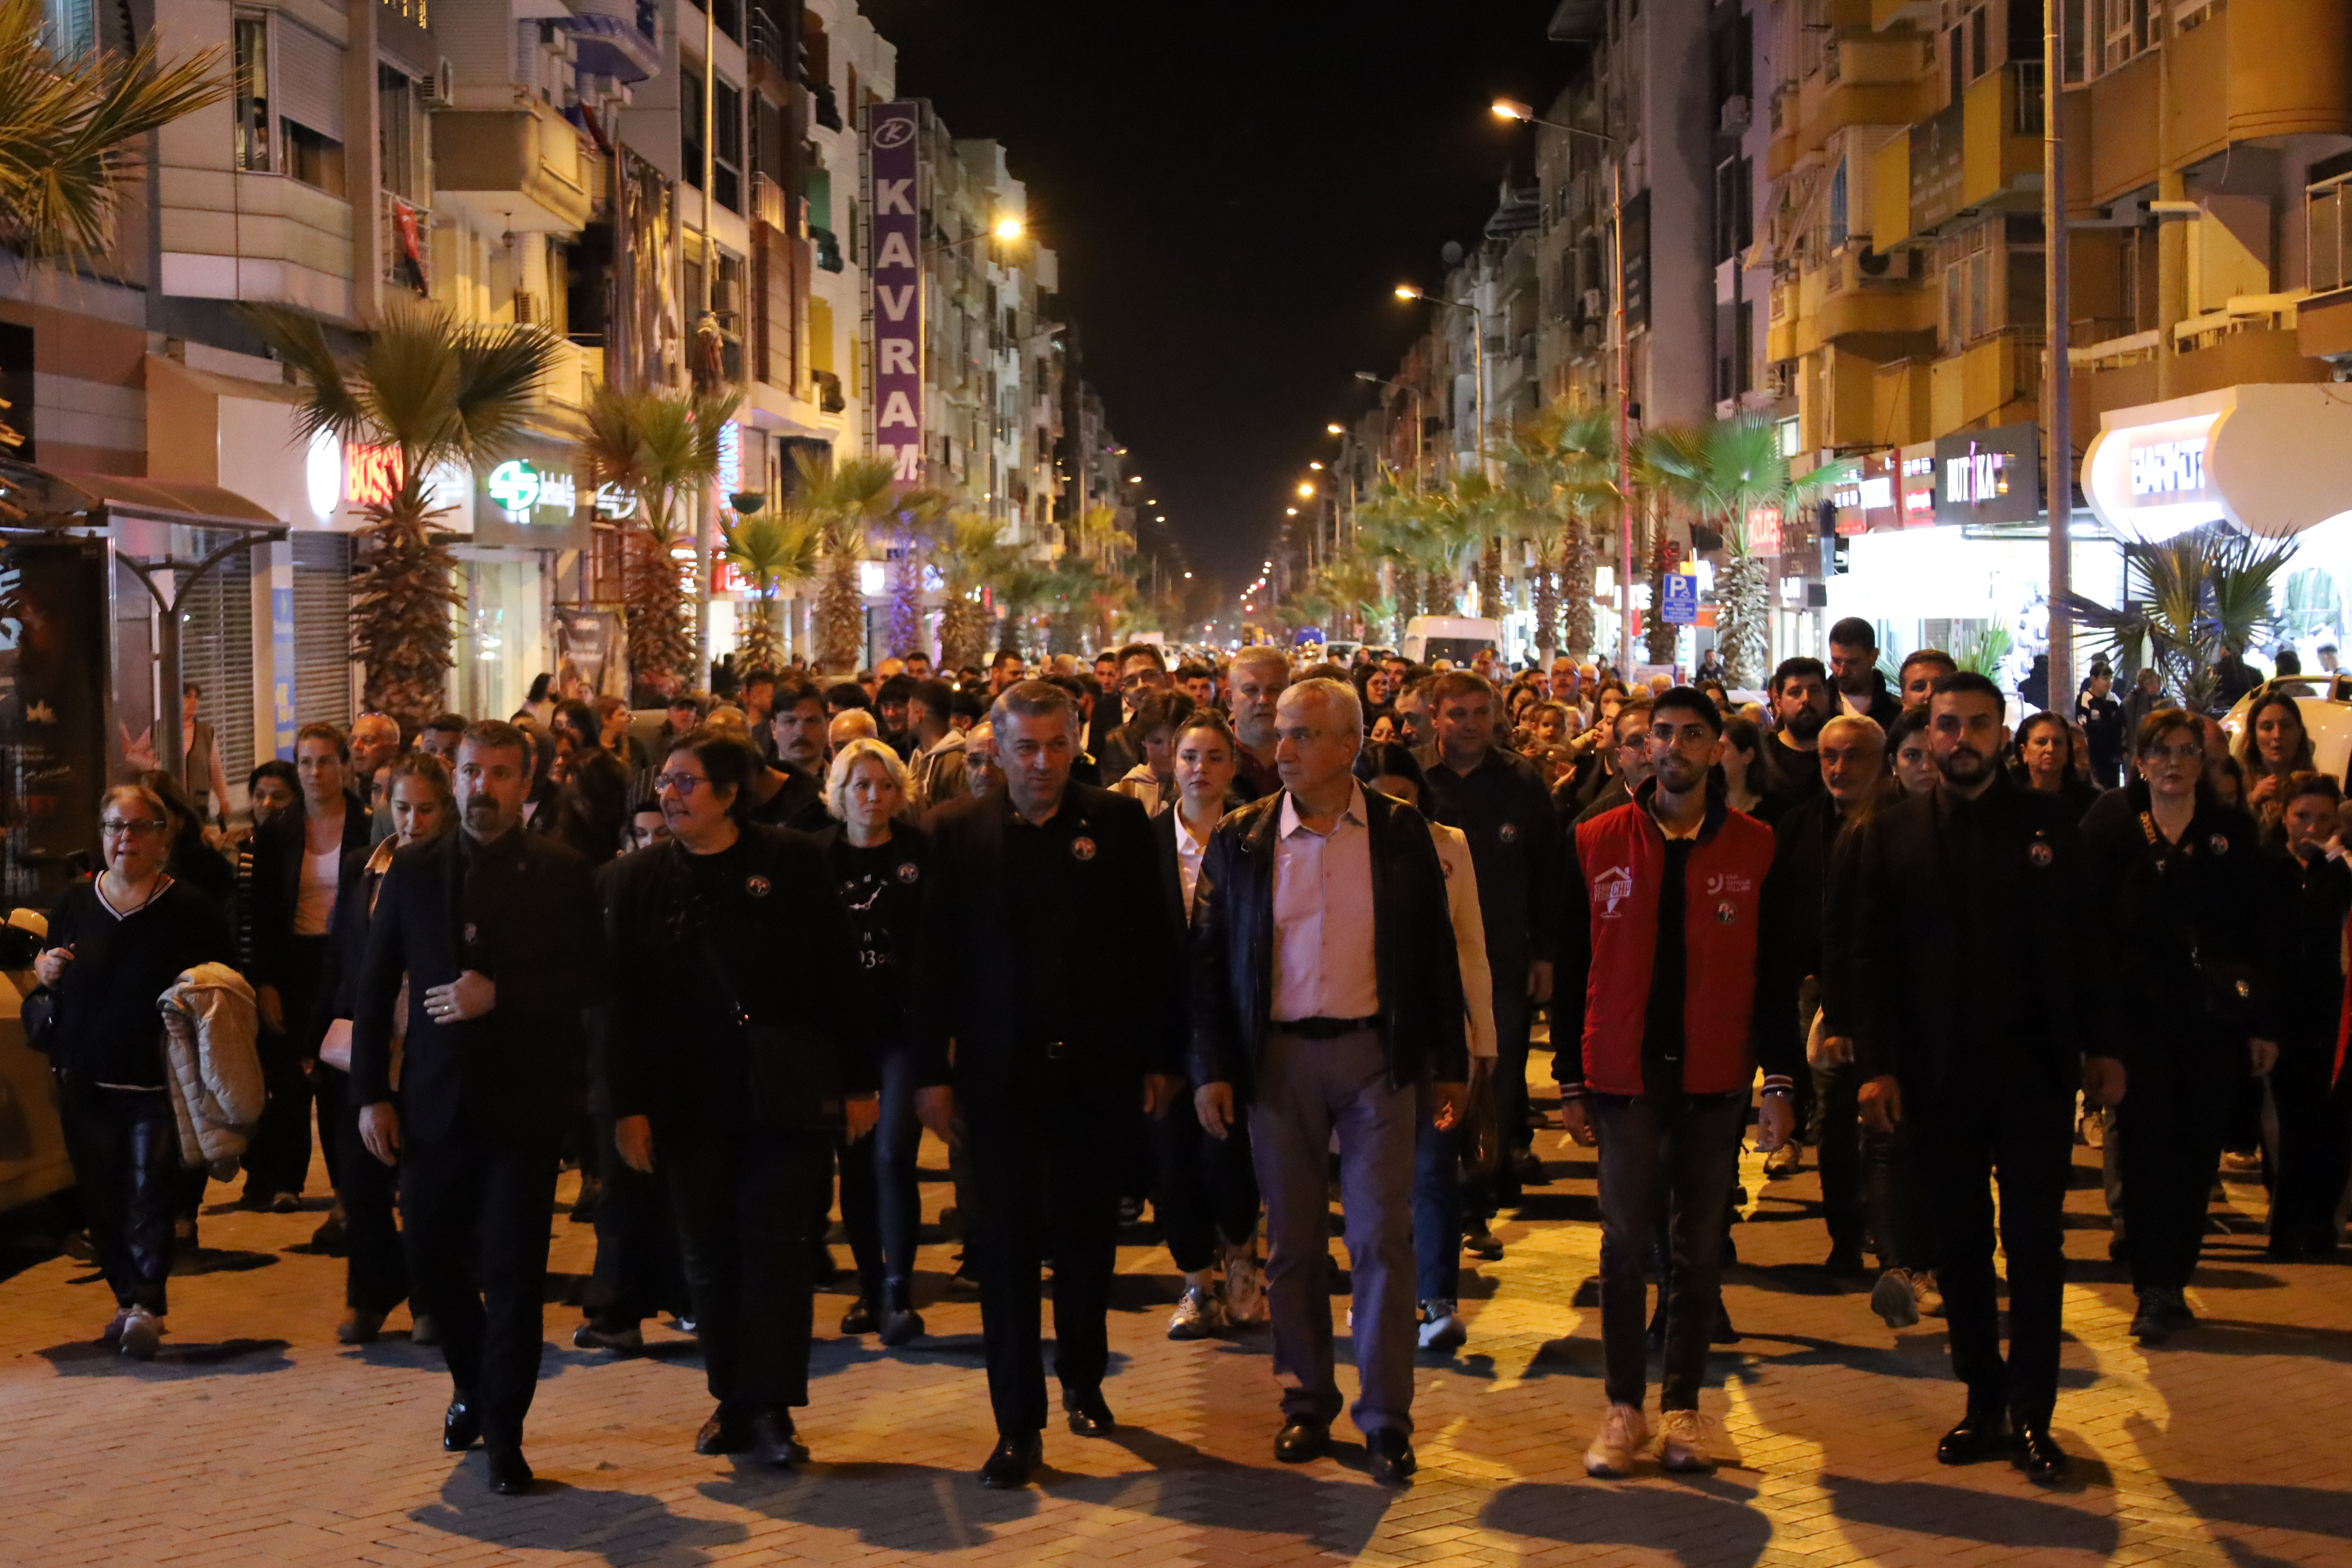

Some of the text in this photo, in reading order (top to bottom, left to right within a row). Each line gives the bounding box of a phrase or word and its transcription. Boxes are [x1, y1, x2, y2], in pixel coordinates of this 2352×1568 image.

[877, 178, 919, 481] KAVRAM
[1670, 576, 1687, 597] P
[1612, 881, 1632, 896] CHP
